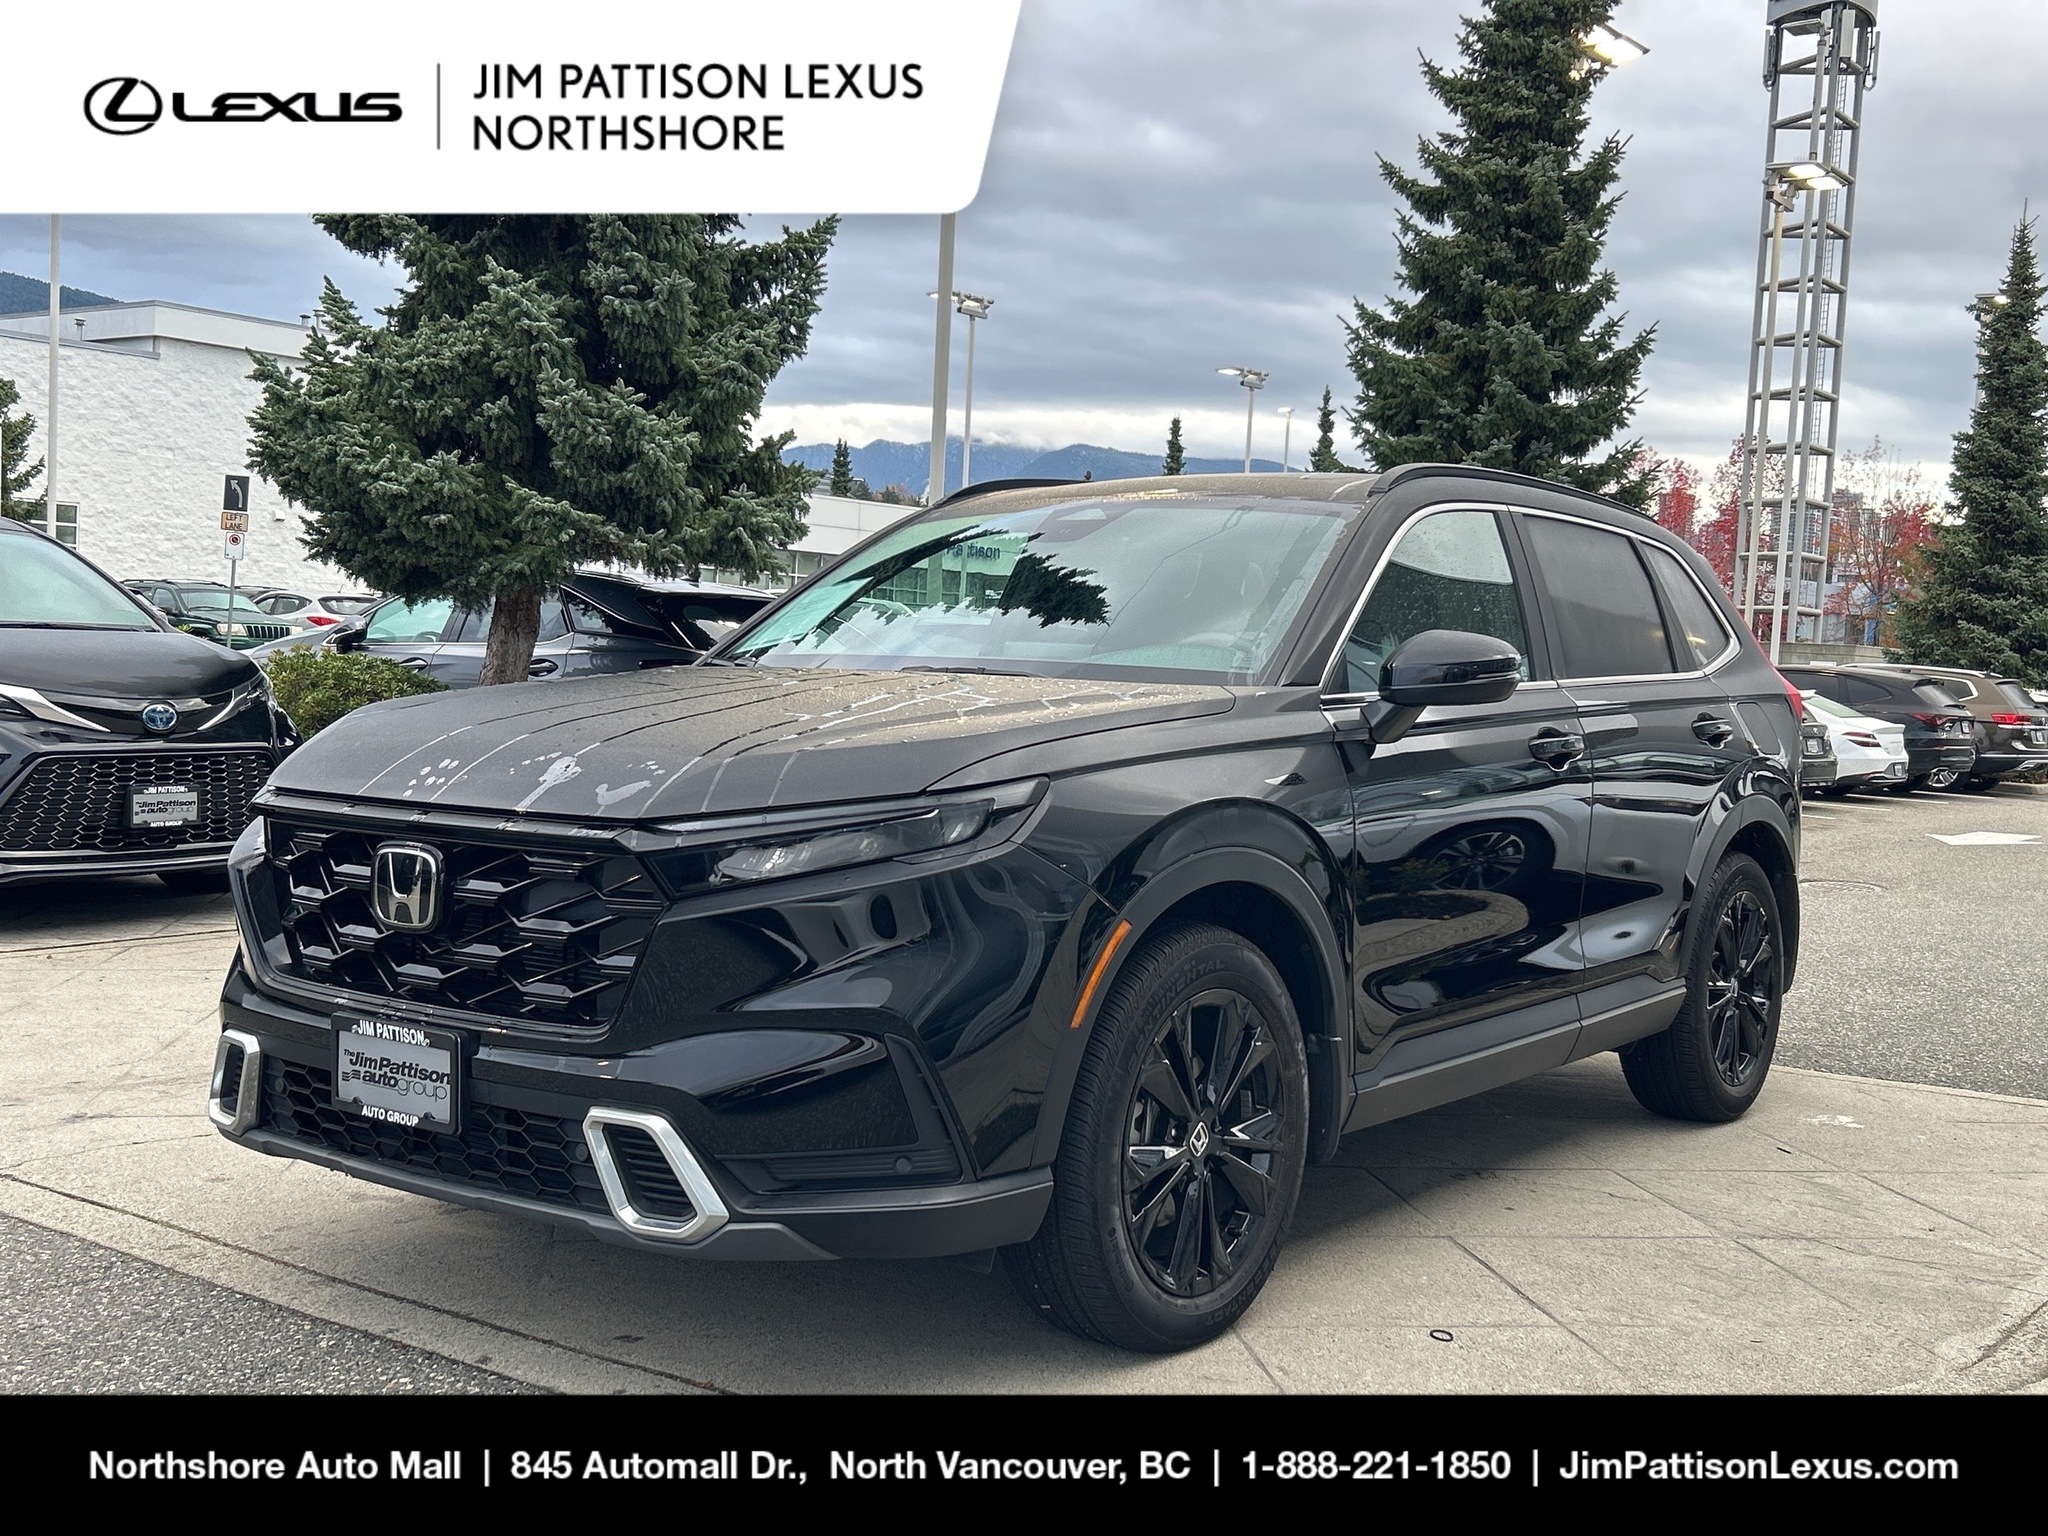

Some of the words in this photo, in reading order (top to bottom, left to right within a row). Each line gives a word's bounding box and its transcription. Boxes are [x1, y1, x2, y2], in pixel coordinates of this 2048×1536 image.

[226, 513, 243, 522] LEFT
[225, 522, 243, 531] LANE
[358, 1020, 375, 1036] JIM
[376, 1023, 426, 1046] PATTISON
[361, 1105, 385, 1120] AUTO
[387, 1111, 419, 1127] GROUP
